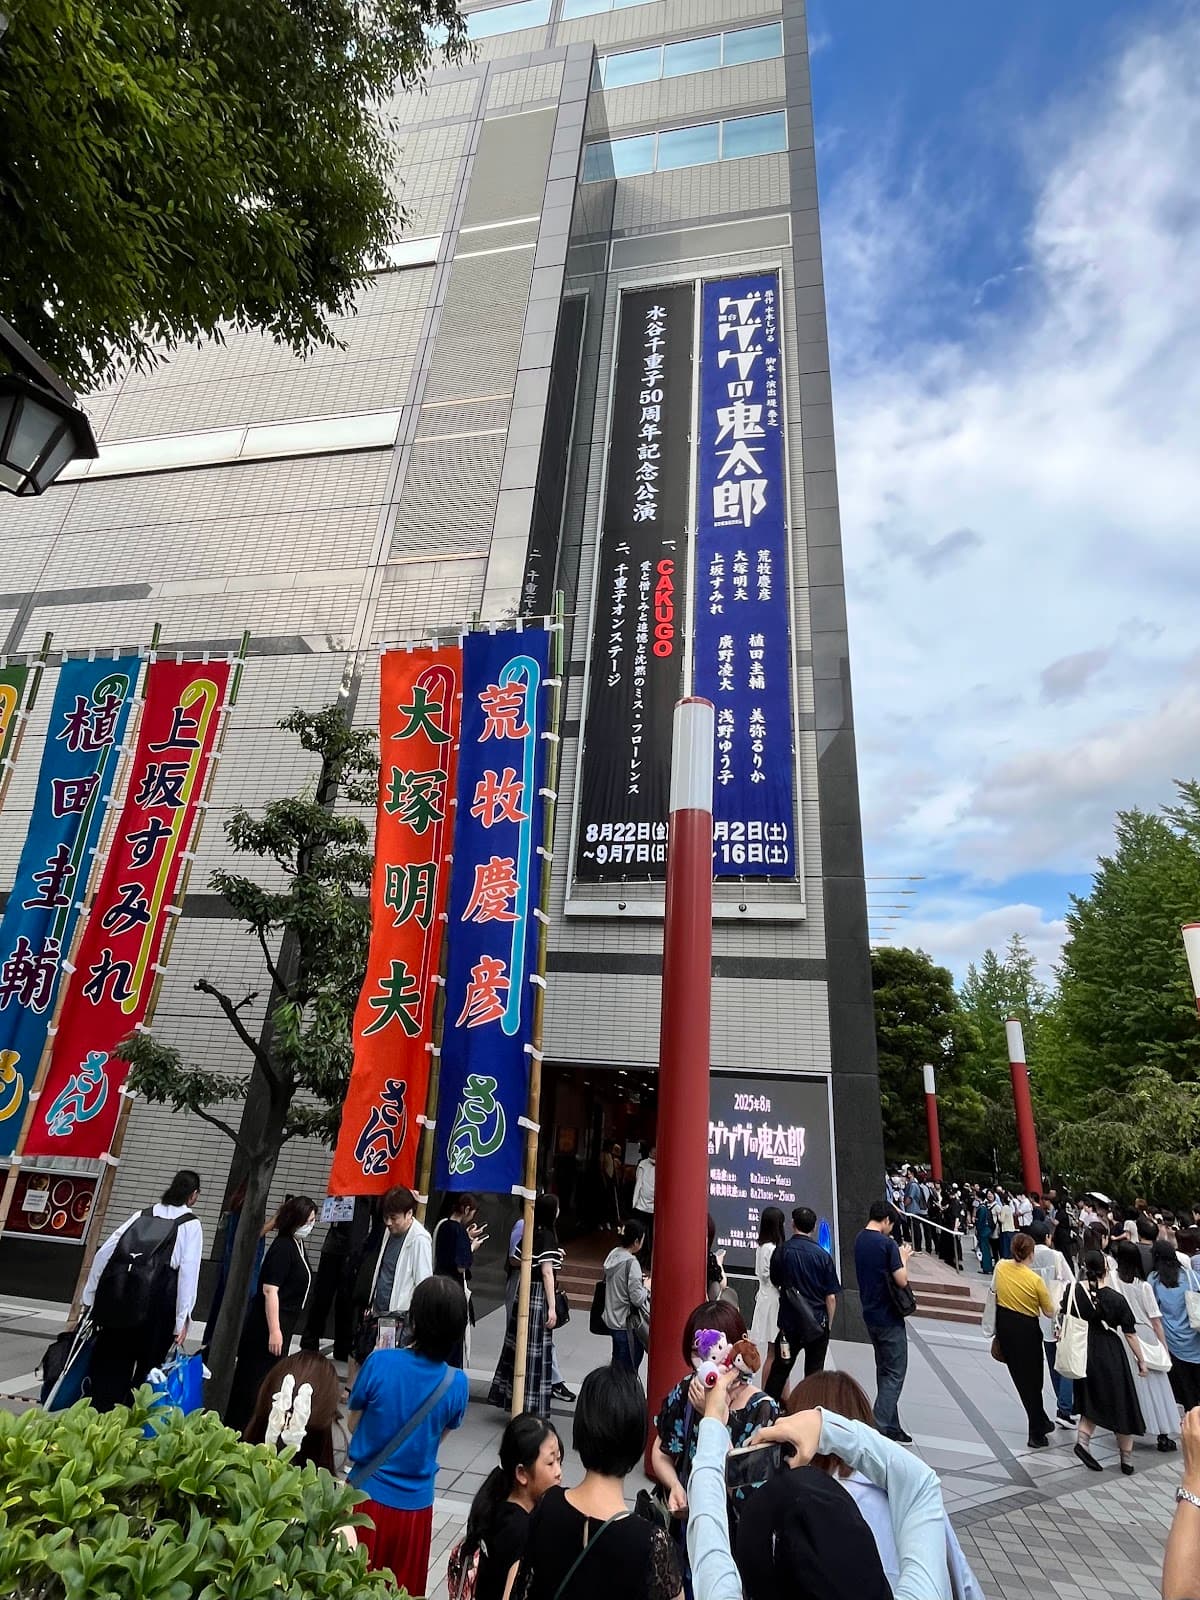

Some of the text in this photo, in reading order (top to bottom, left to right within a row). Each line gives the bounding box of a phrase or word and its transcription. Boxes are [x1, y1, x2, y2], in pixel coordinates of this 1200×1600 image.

[632, 304, 668, 522] 水谷千重子50周年記念公演
[713, 290, 768, 528] ゲゲゲの鬼太郎
[652, 559, 675, 658] CAKUGO
[709, 552, 725, 615] 上坂すみれ
[733, 549, 749, 601] 大塚明夫
[757, 549, 771, 601] 荒牧慶彦
[607, 563, 630, 688] 千重子オンステージ
[748, 633, 766, 690] 植田圭輔
[717, 708, 735, 786] 浅野ゆう子
[748, 707, 766, 784] 美弥るりか
[83, 706, 202, 1006] 上坂すみれ
[362, 686, 453, 1038] 大塚明夫
[455, 682, 531, 1030] 荒牧慶彦
[713, 821, 788, 842] 月2日(土)
[734, 1093, 771, 1113] 2025年8月
